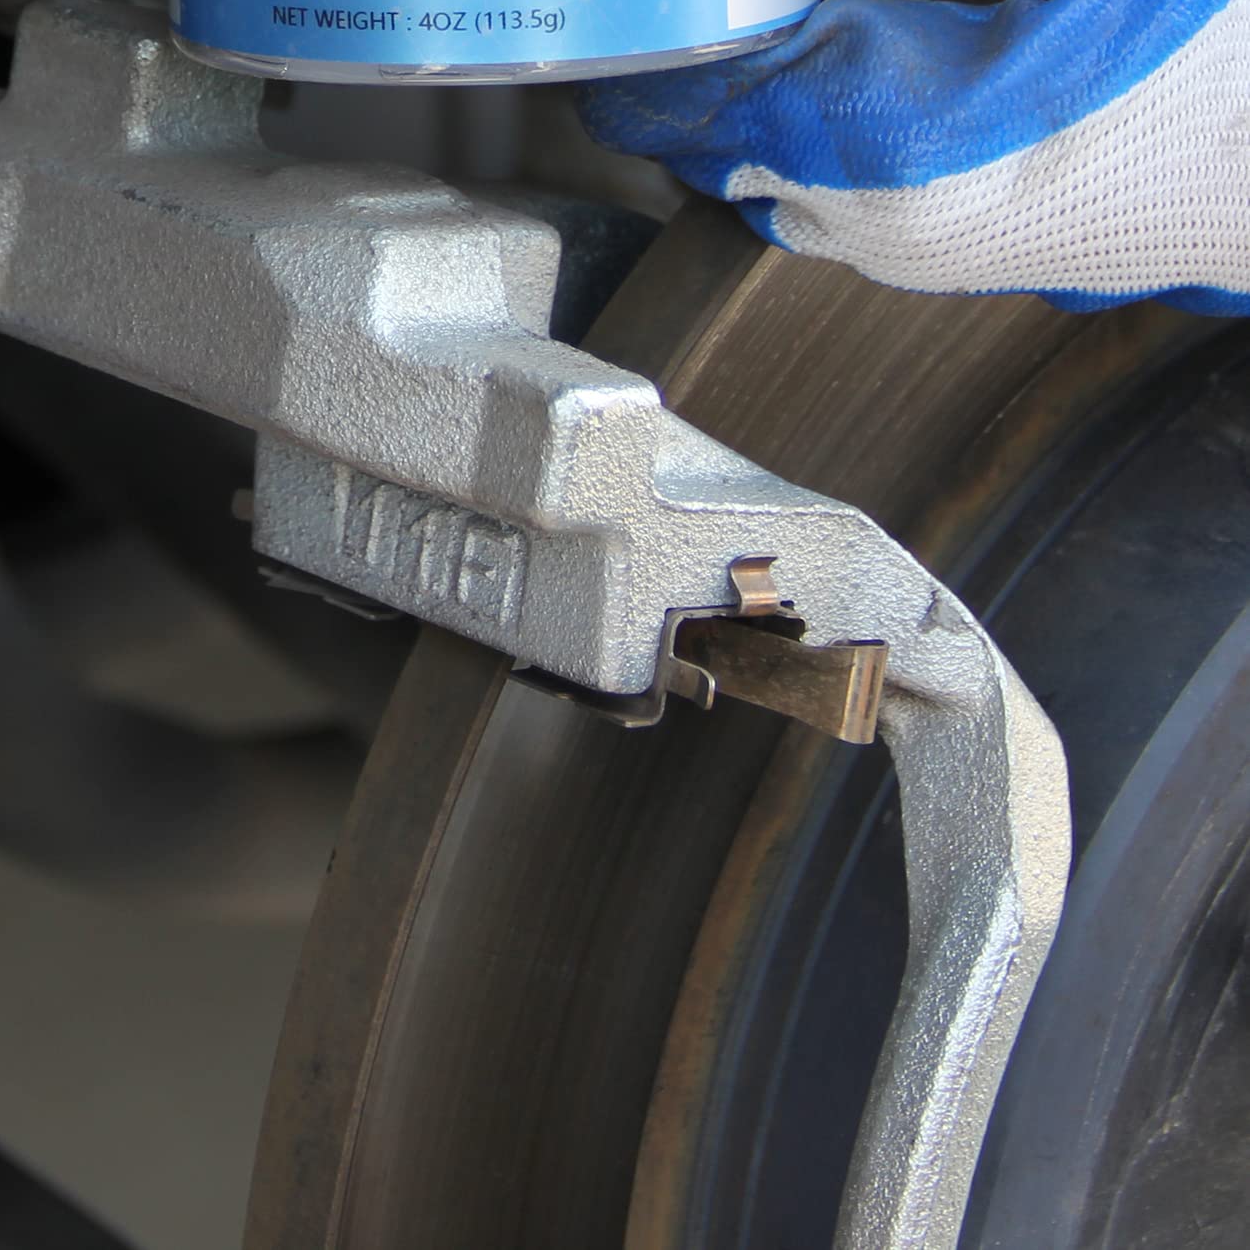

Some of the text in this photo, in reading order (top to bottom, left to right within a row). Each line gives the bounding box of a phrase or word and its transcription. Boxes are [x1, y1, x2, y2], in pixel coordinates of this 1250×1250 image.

[273, 6, 308, 28] NET
[315, 10, 399, 32] WEIGHT
[475, 7, 566, 34] (113.5g)
